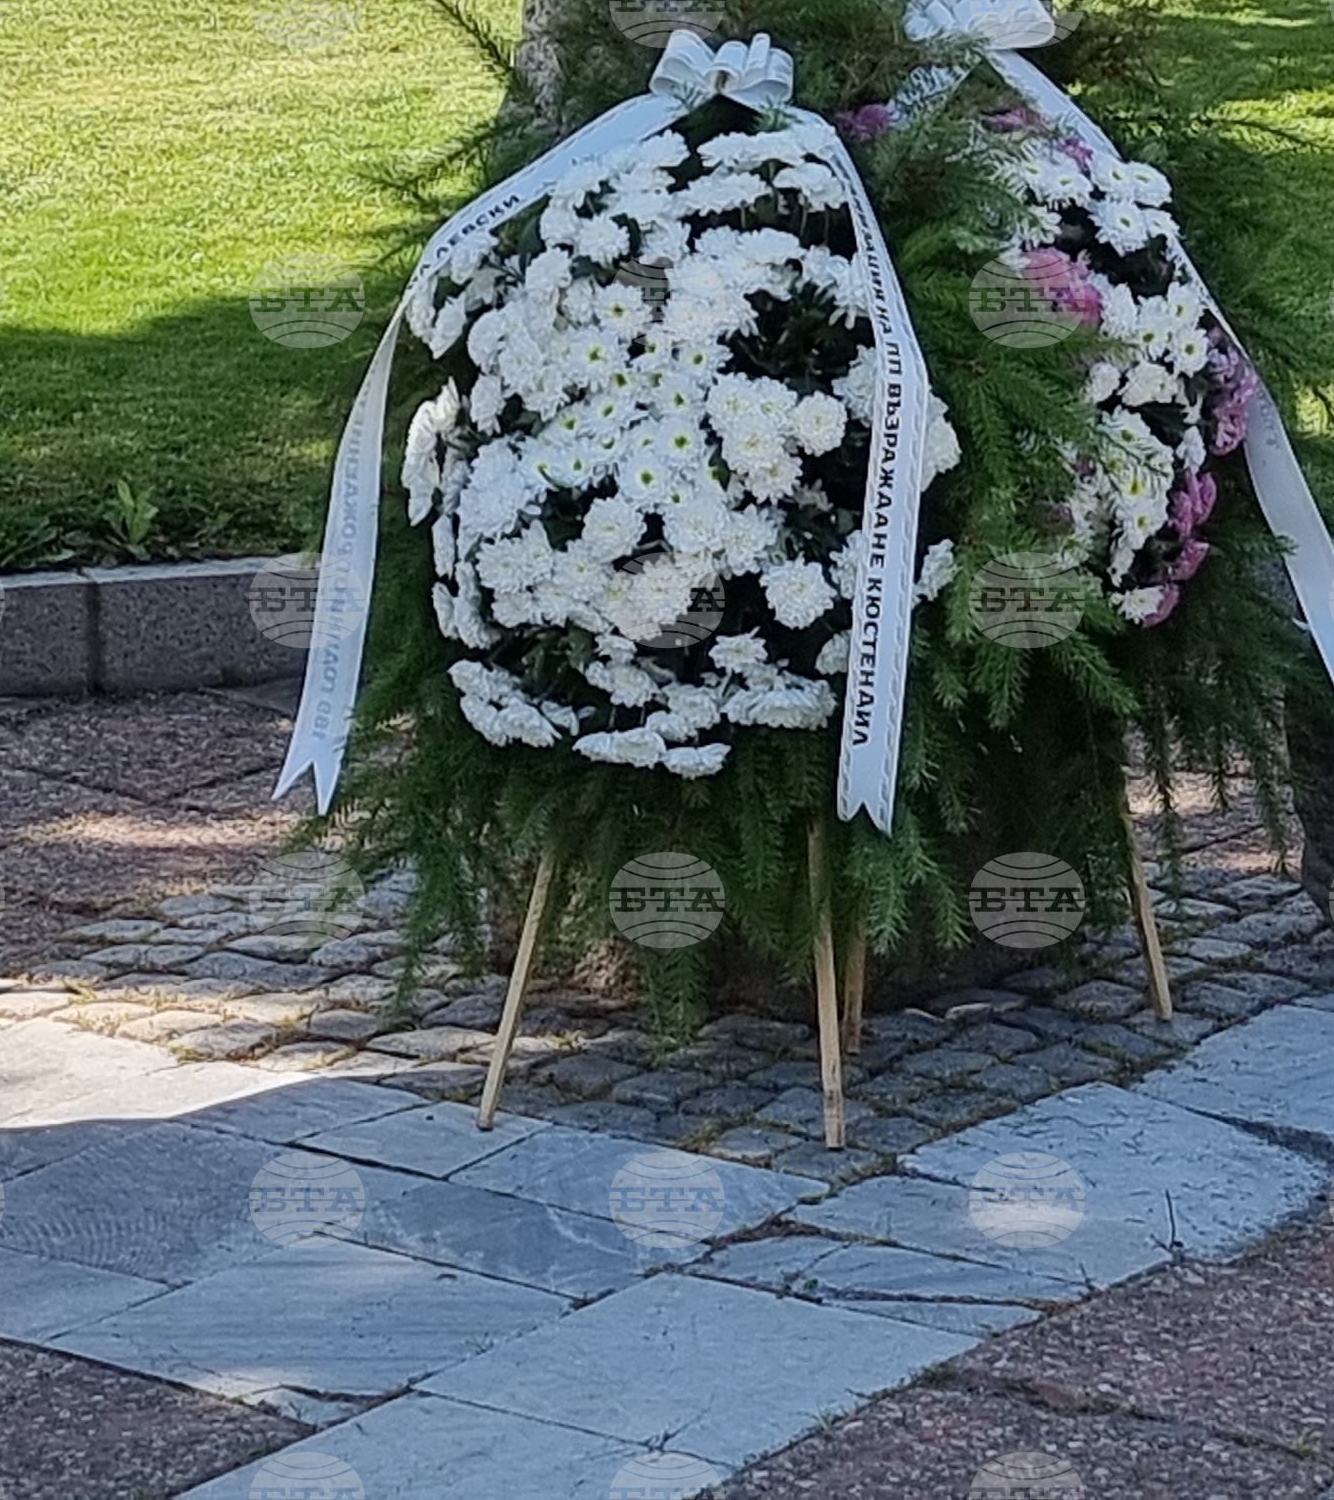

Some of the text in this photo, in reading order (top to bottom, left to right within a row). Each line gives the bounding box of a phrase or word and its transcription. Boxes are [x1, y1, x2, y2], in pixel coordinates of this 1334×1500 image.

[885, 342, 903, 376] ПП
[869, 383, 903, 569] ВЪЗРАЖДАНЕ
[852, 577, 883, 747] КЮСТЕНДИЛ
